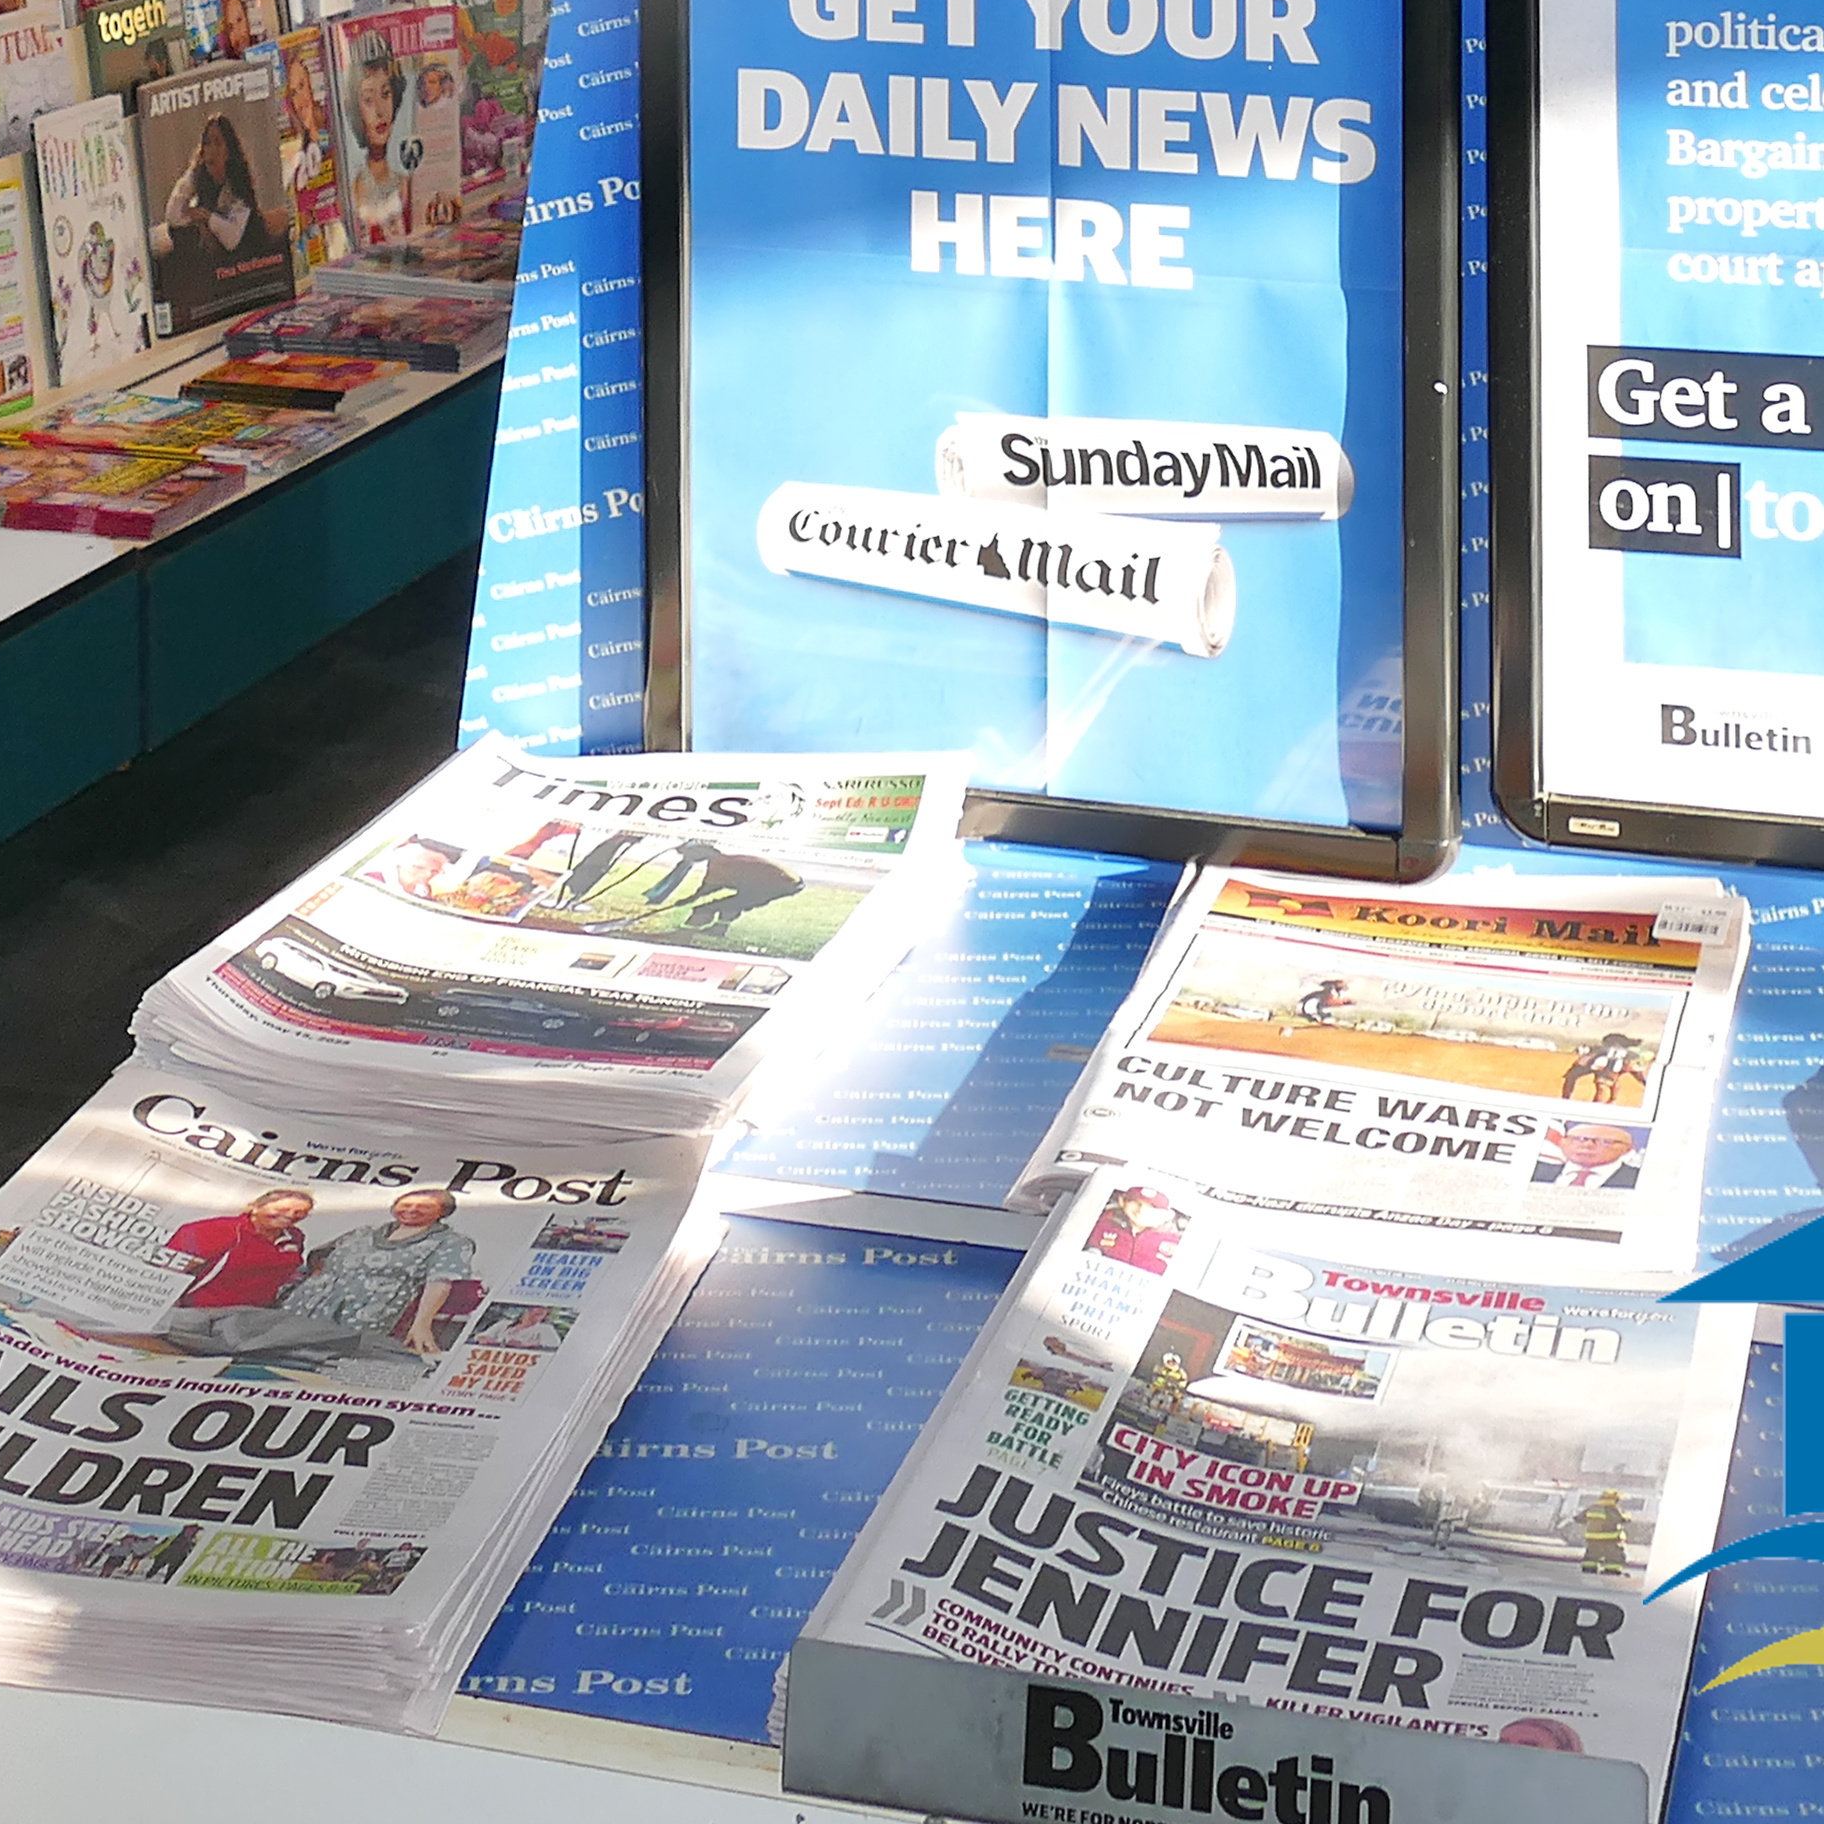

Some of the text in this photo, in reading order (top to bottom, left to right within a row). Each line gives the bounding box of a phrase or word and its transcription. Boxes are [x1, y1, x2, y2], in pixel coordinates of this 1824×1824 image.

[736, 67, 1378, 185] DAILY NEWS
[1665, 71, 1750, 112] and
[909, 189, 1195, 291] HERE
[1667, 253, 1785, 289] court
[1596, 358, 1739, 432] Get
[1760, 381, 1810, 436] a
[1597, 477, 1703, 536] on
[787, 507, 1163, 606] Courier Mail
[1660, 702, 1814, 757] Bulletin
[1349, 903, 1661, 949] Koori Mail
[1112, 1081, 1517, 1168] NOT WELCOME
[1114, 1054, 1540, 1140] CULTURE WARS
[130, 1092, 636, 1210] Cairns Post
[63, 1176, 163, 1222] INSIDE
[1321, 1268, 1547, 1313] Townsville
[167, 1396, 397, 1469] OUR
[1112, 1426, 1360, 1502] CITY ICON UP
[1133, 1460, 1320, 1520] IN SMOKE
[937, 1461, 1626, 1661] JUSTICE FOR
[900, 1522, 1443, 1712] JENNIFER
[1022, 1683, 1393, 1824] Bulletin
[1108, 1697, 1235, 1740] Townsville
